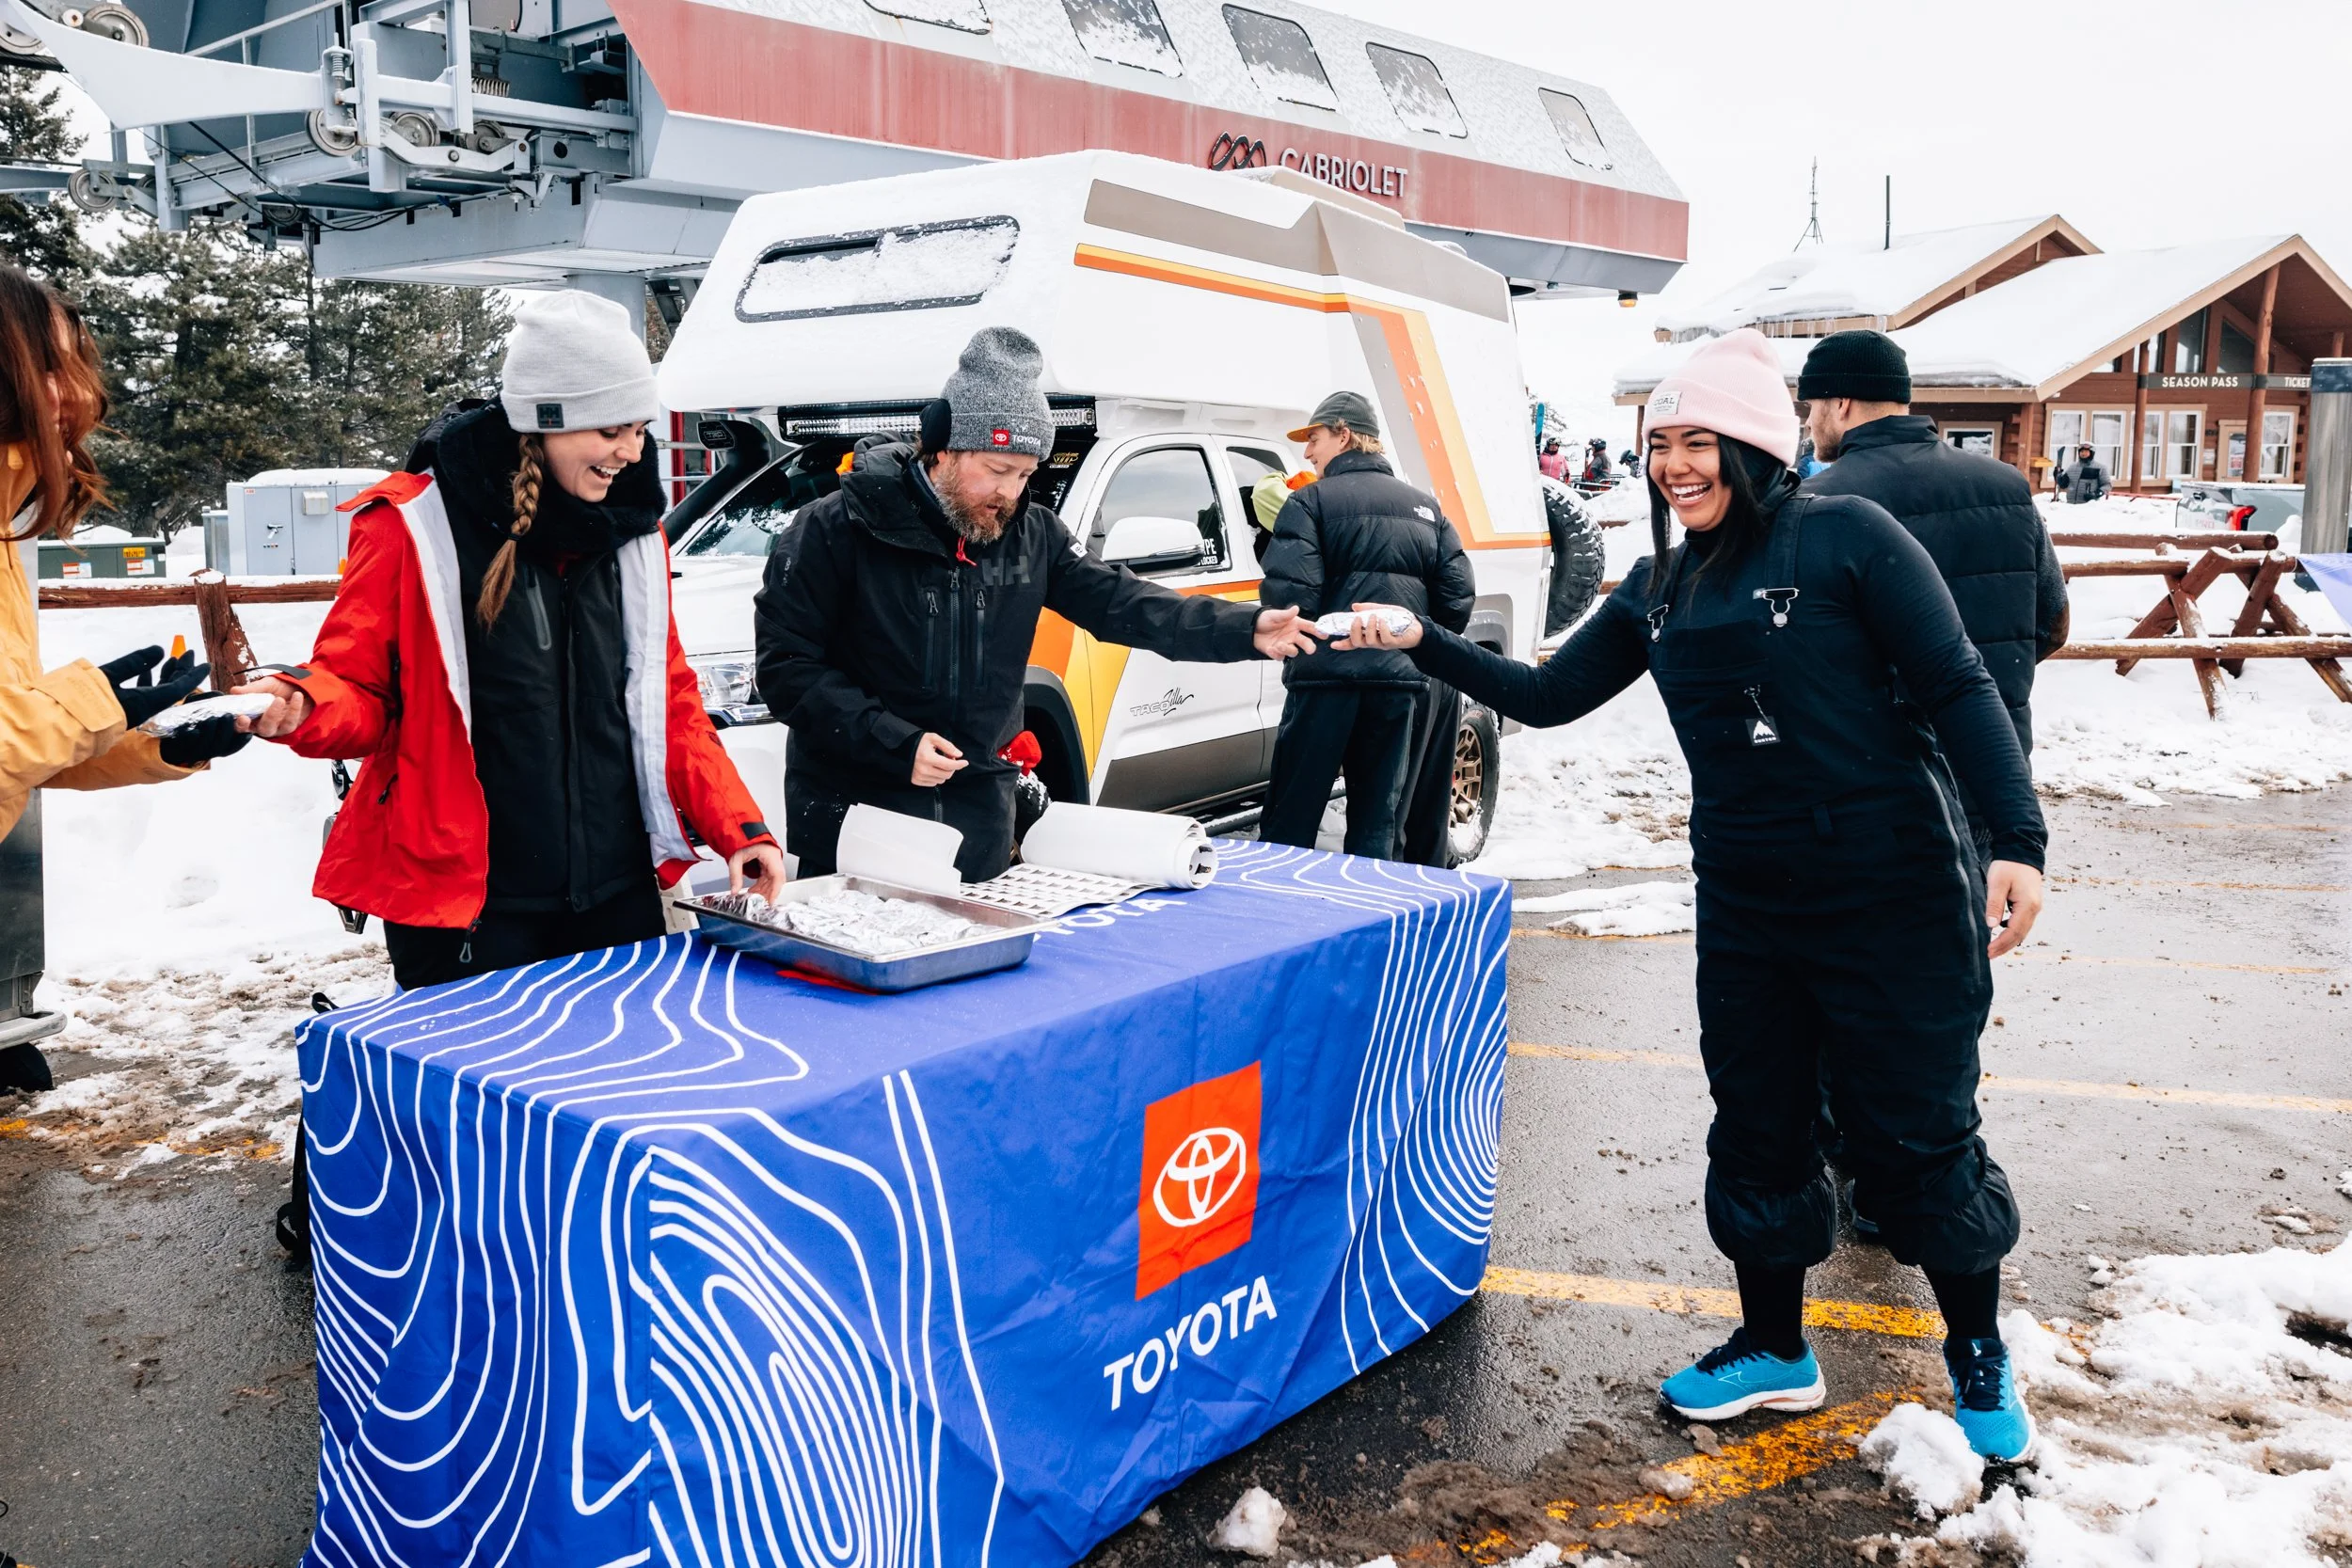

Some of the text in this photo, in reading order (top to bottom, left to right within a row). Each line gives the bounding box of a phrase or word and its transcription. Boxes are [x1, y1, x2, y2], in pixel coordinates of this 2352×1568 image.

[1280, 148, 1407, 198] CABRIOLET
[2162, 376, 2238, 388] SEASON PASS
[2284, 377, 2311, 388] TICKET
[1012, 434, 1041, 447] TOYOTA
[981, 555, 1031, 586] HH
[1104, 1275, 1278, 1412] TOYOTA
